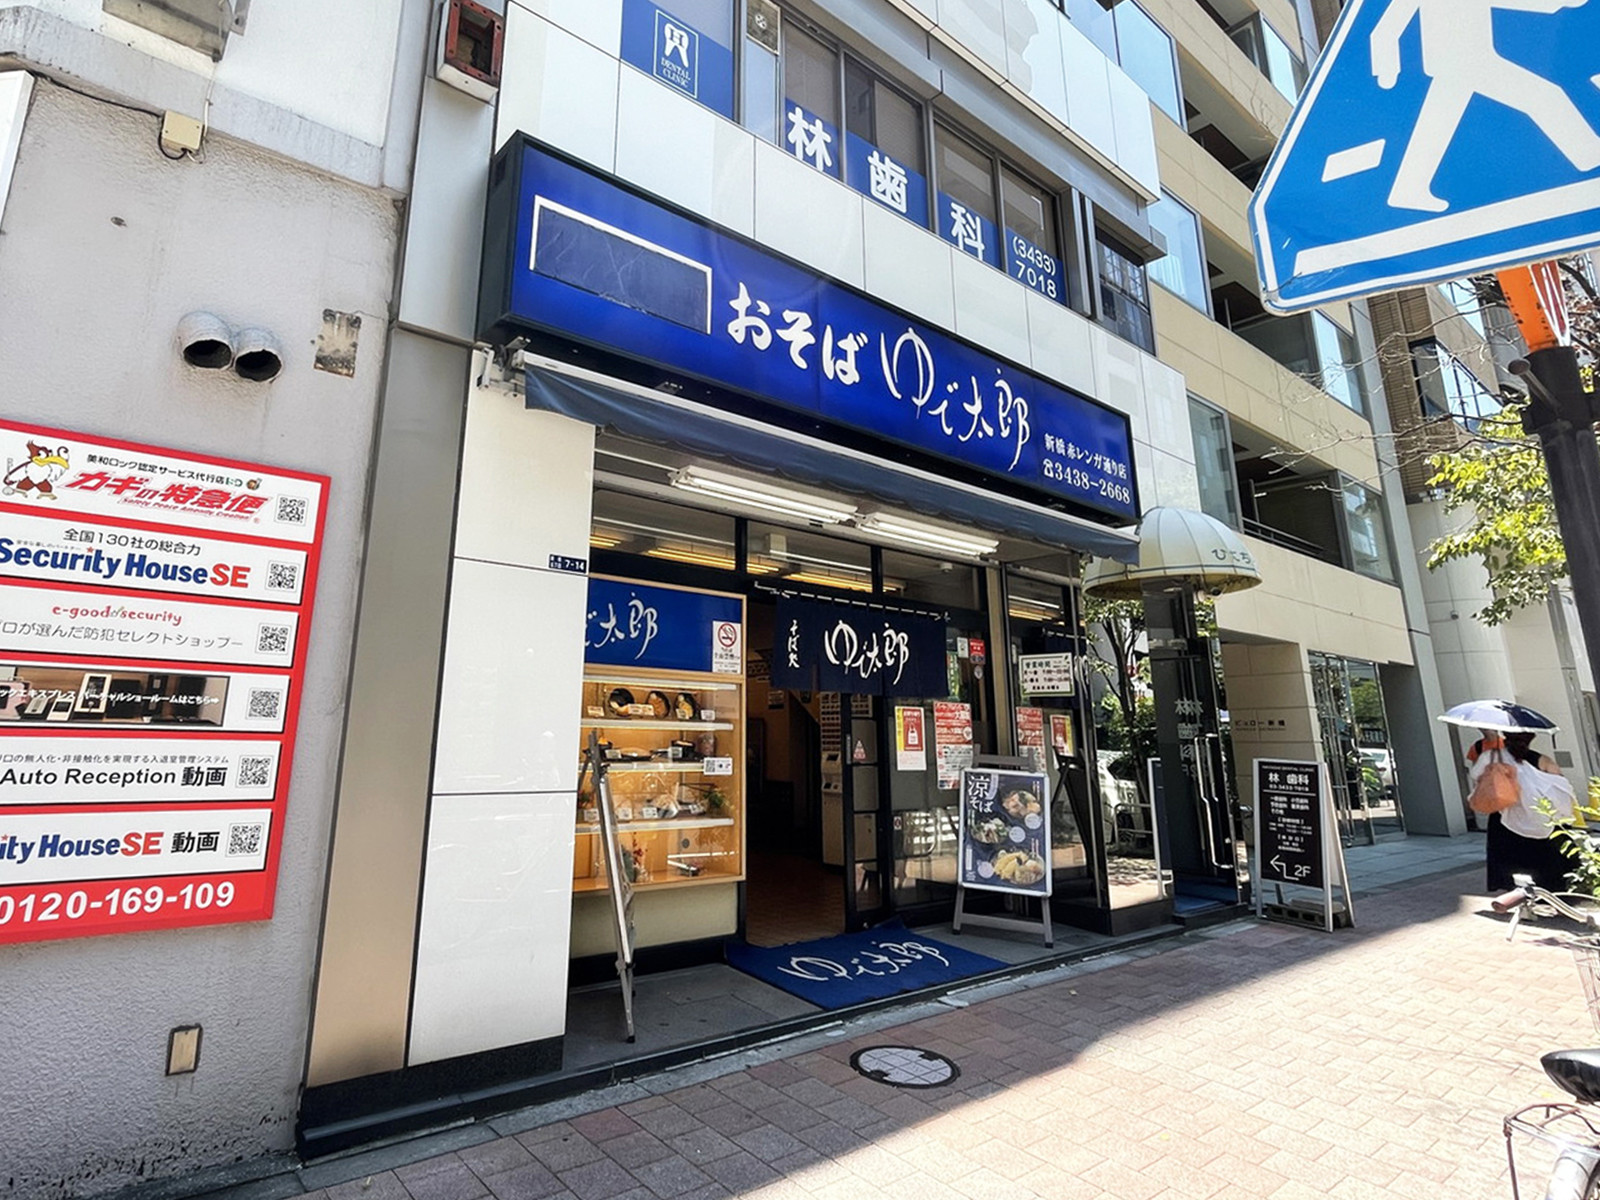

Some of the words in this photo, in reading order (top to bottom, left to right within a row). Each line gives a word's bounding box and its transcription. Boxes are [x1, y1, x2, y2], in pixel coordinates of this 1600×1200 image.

[661, 57, 691, 81] DENTAL
[662, 67, 688, 87] CLINIC
[1012, 234, 1057, 278] (3433)
[1016, 260, 1057, 300] 7018
[726, 281, 867, 386] おそば
[880, 326, 1031, 472] ゆで太郎
[1044, 432, 1127, 480] 新橋赤レンガ通り店
[65, 470, 269, 514] カギの特急便
[0, 537, 121, 579] Security
[62, 528, 201, 557] 全国130社の総合力
[0, 768, 58, 785] Auto
[64, 768, 176, 788] Reception
[180, 766, 228, 788] 動画
[170, 831, 220, 853] 動画
[1293, 864, 1312, 878] 2F
[0, 880, 236, 925] 0120-169-109
